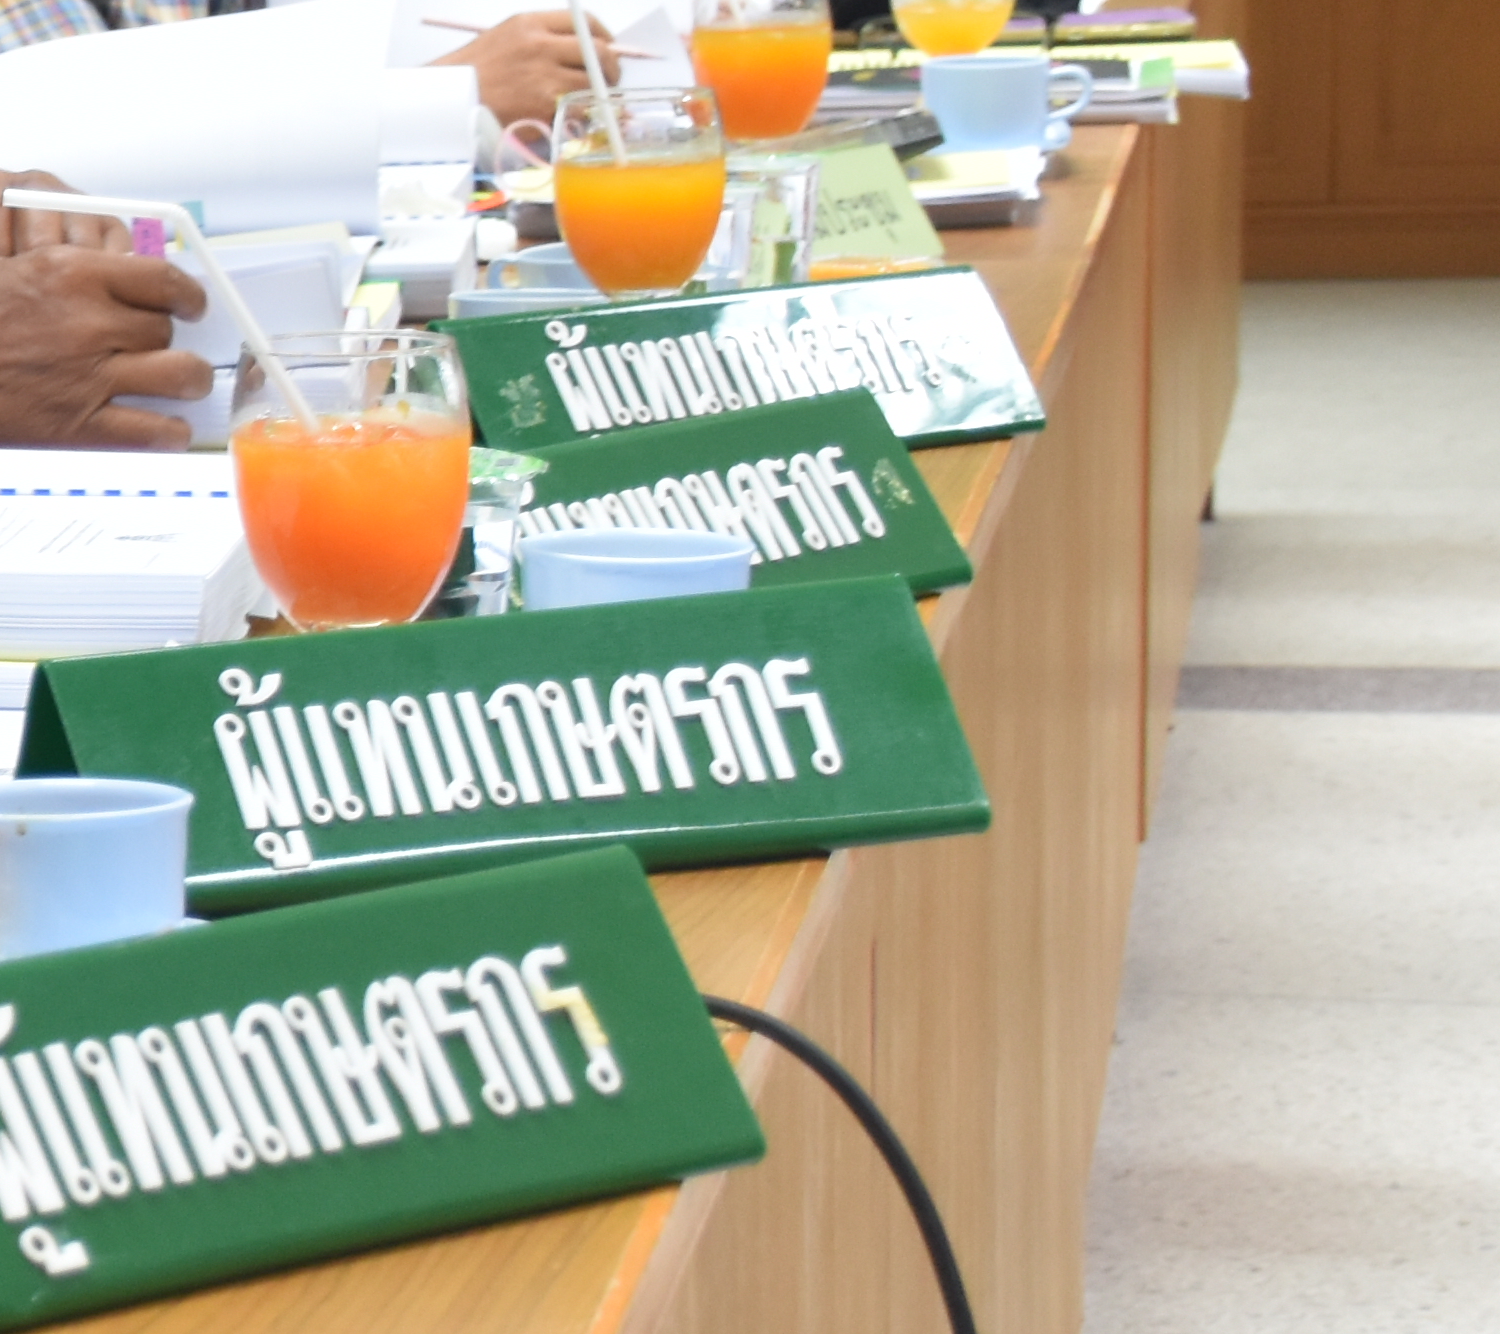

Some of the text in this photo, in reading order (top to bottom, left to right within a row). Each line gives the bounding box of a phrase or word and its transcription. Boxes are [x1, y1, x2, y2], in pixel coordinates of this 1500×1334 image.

[544, 316, 943, 435] ผ้แทนเกษตรกร
[214, 657, 842, 869] ผู้แทนเกษตรกร
